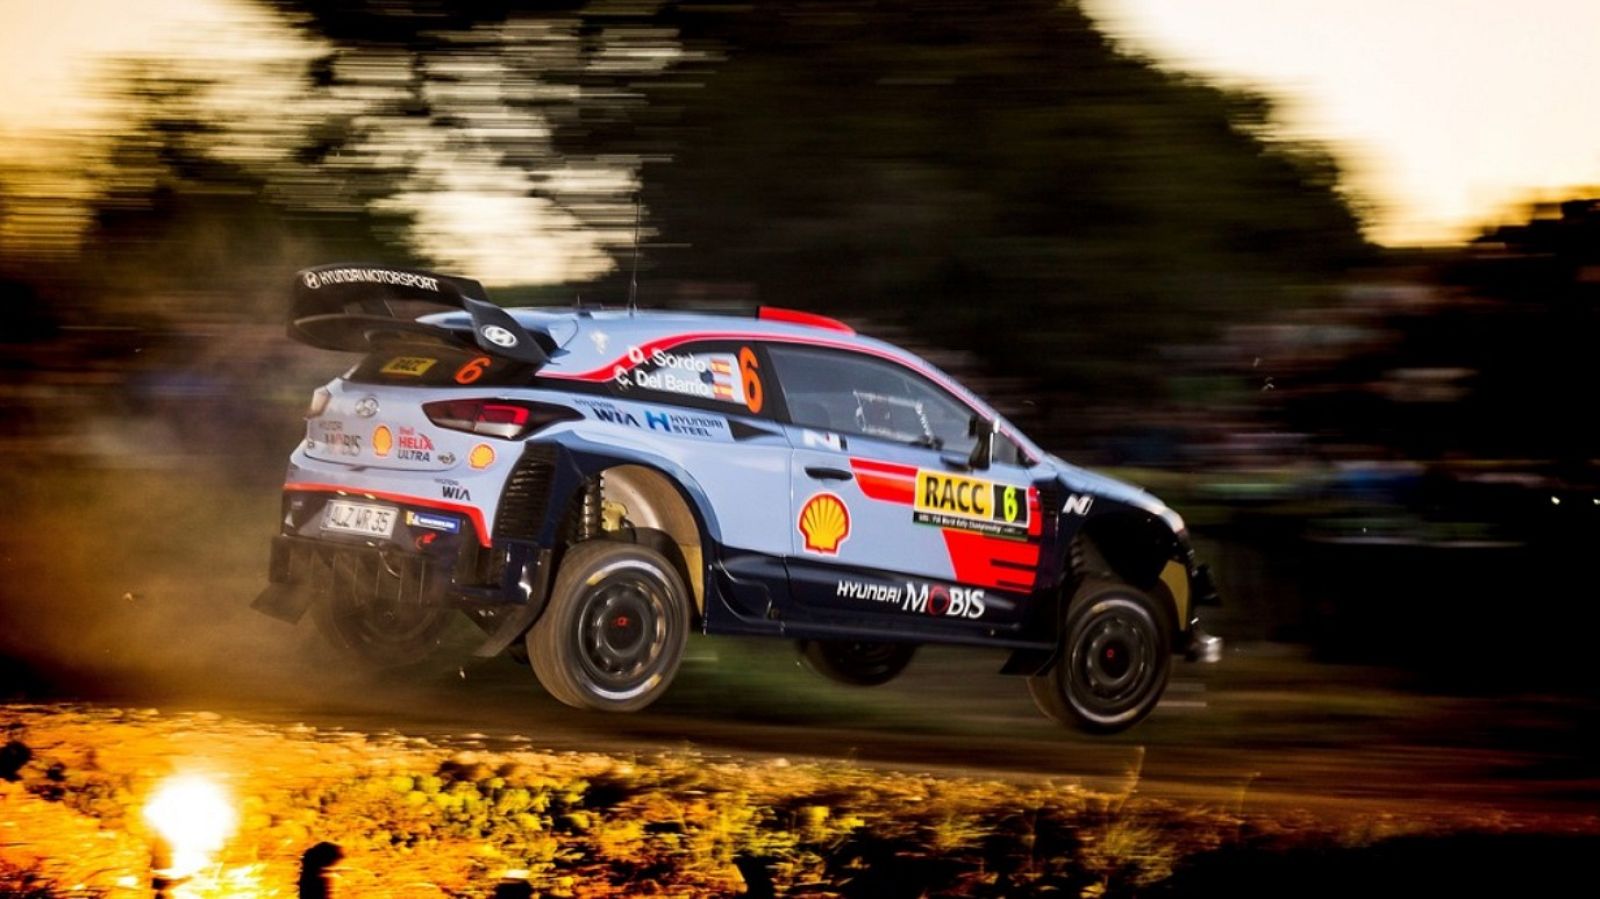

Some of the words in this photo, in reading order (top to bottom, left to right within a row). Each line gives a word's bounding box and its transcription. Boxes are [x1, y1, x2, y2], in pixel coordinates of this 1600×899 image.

[455, 356, 491, 384] 6
[652, 349, 706, 373] Sordo
[636, 370, 662, 389] Del
[665, 376, 710, 396] Barrio
[739, 346, 763, 413] 6
[592, 407, 642, 427] WIA
[671, 414, 723, 429] HYUNDAI
[398, 435, 435, 450] HELIX
[672, 425, 713, 437] STEEL
[398, 450, 431, 463] ULTRA
[441, 485, 472, 501] WIA
[924, 476, 985, 515] RACC
[1003, 485, 1018, 523] 6
[372, 511, 391, 533] 35
[837, 580, 902, 603] HYUNDAI
[902, 582, 985, 618] MOBIS
